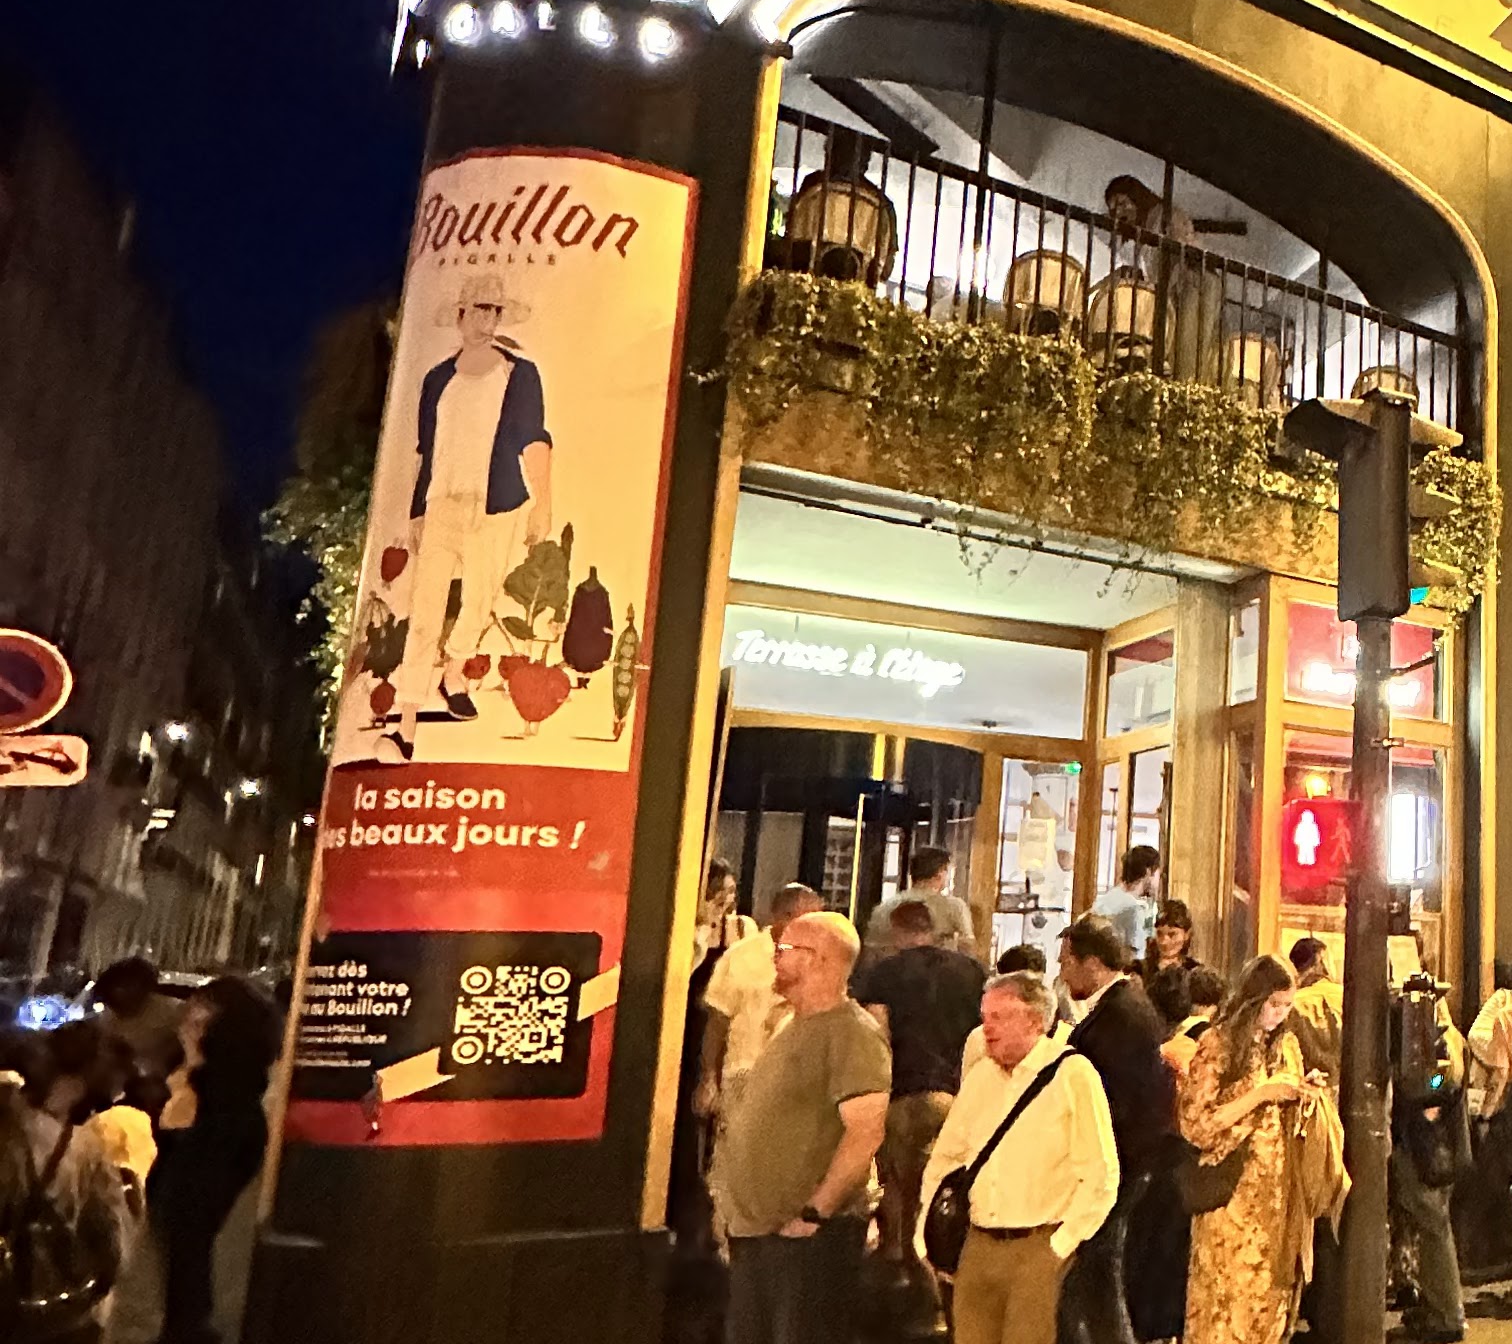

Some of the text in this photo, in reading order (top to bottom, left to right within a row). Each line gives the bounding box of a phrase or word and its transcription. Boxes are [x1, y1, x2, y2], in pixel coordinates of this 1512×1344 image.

[413, 184, 639, 258] Bouillon
[354, 779, 506, 811] la saison
[349, 818, 449, 846] beaux
[451, 816, 559, 853] jours
[569, 820, 586, 849] !
[357, 980, 410, 997] votre
[327, 998, 399, 1016] Bouillon
